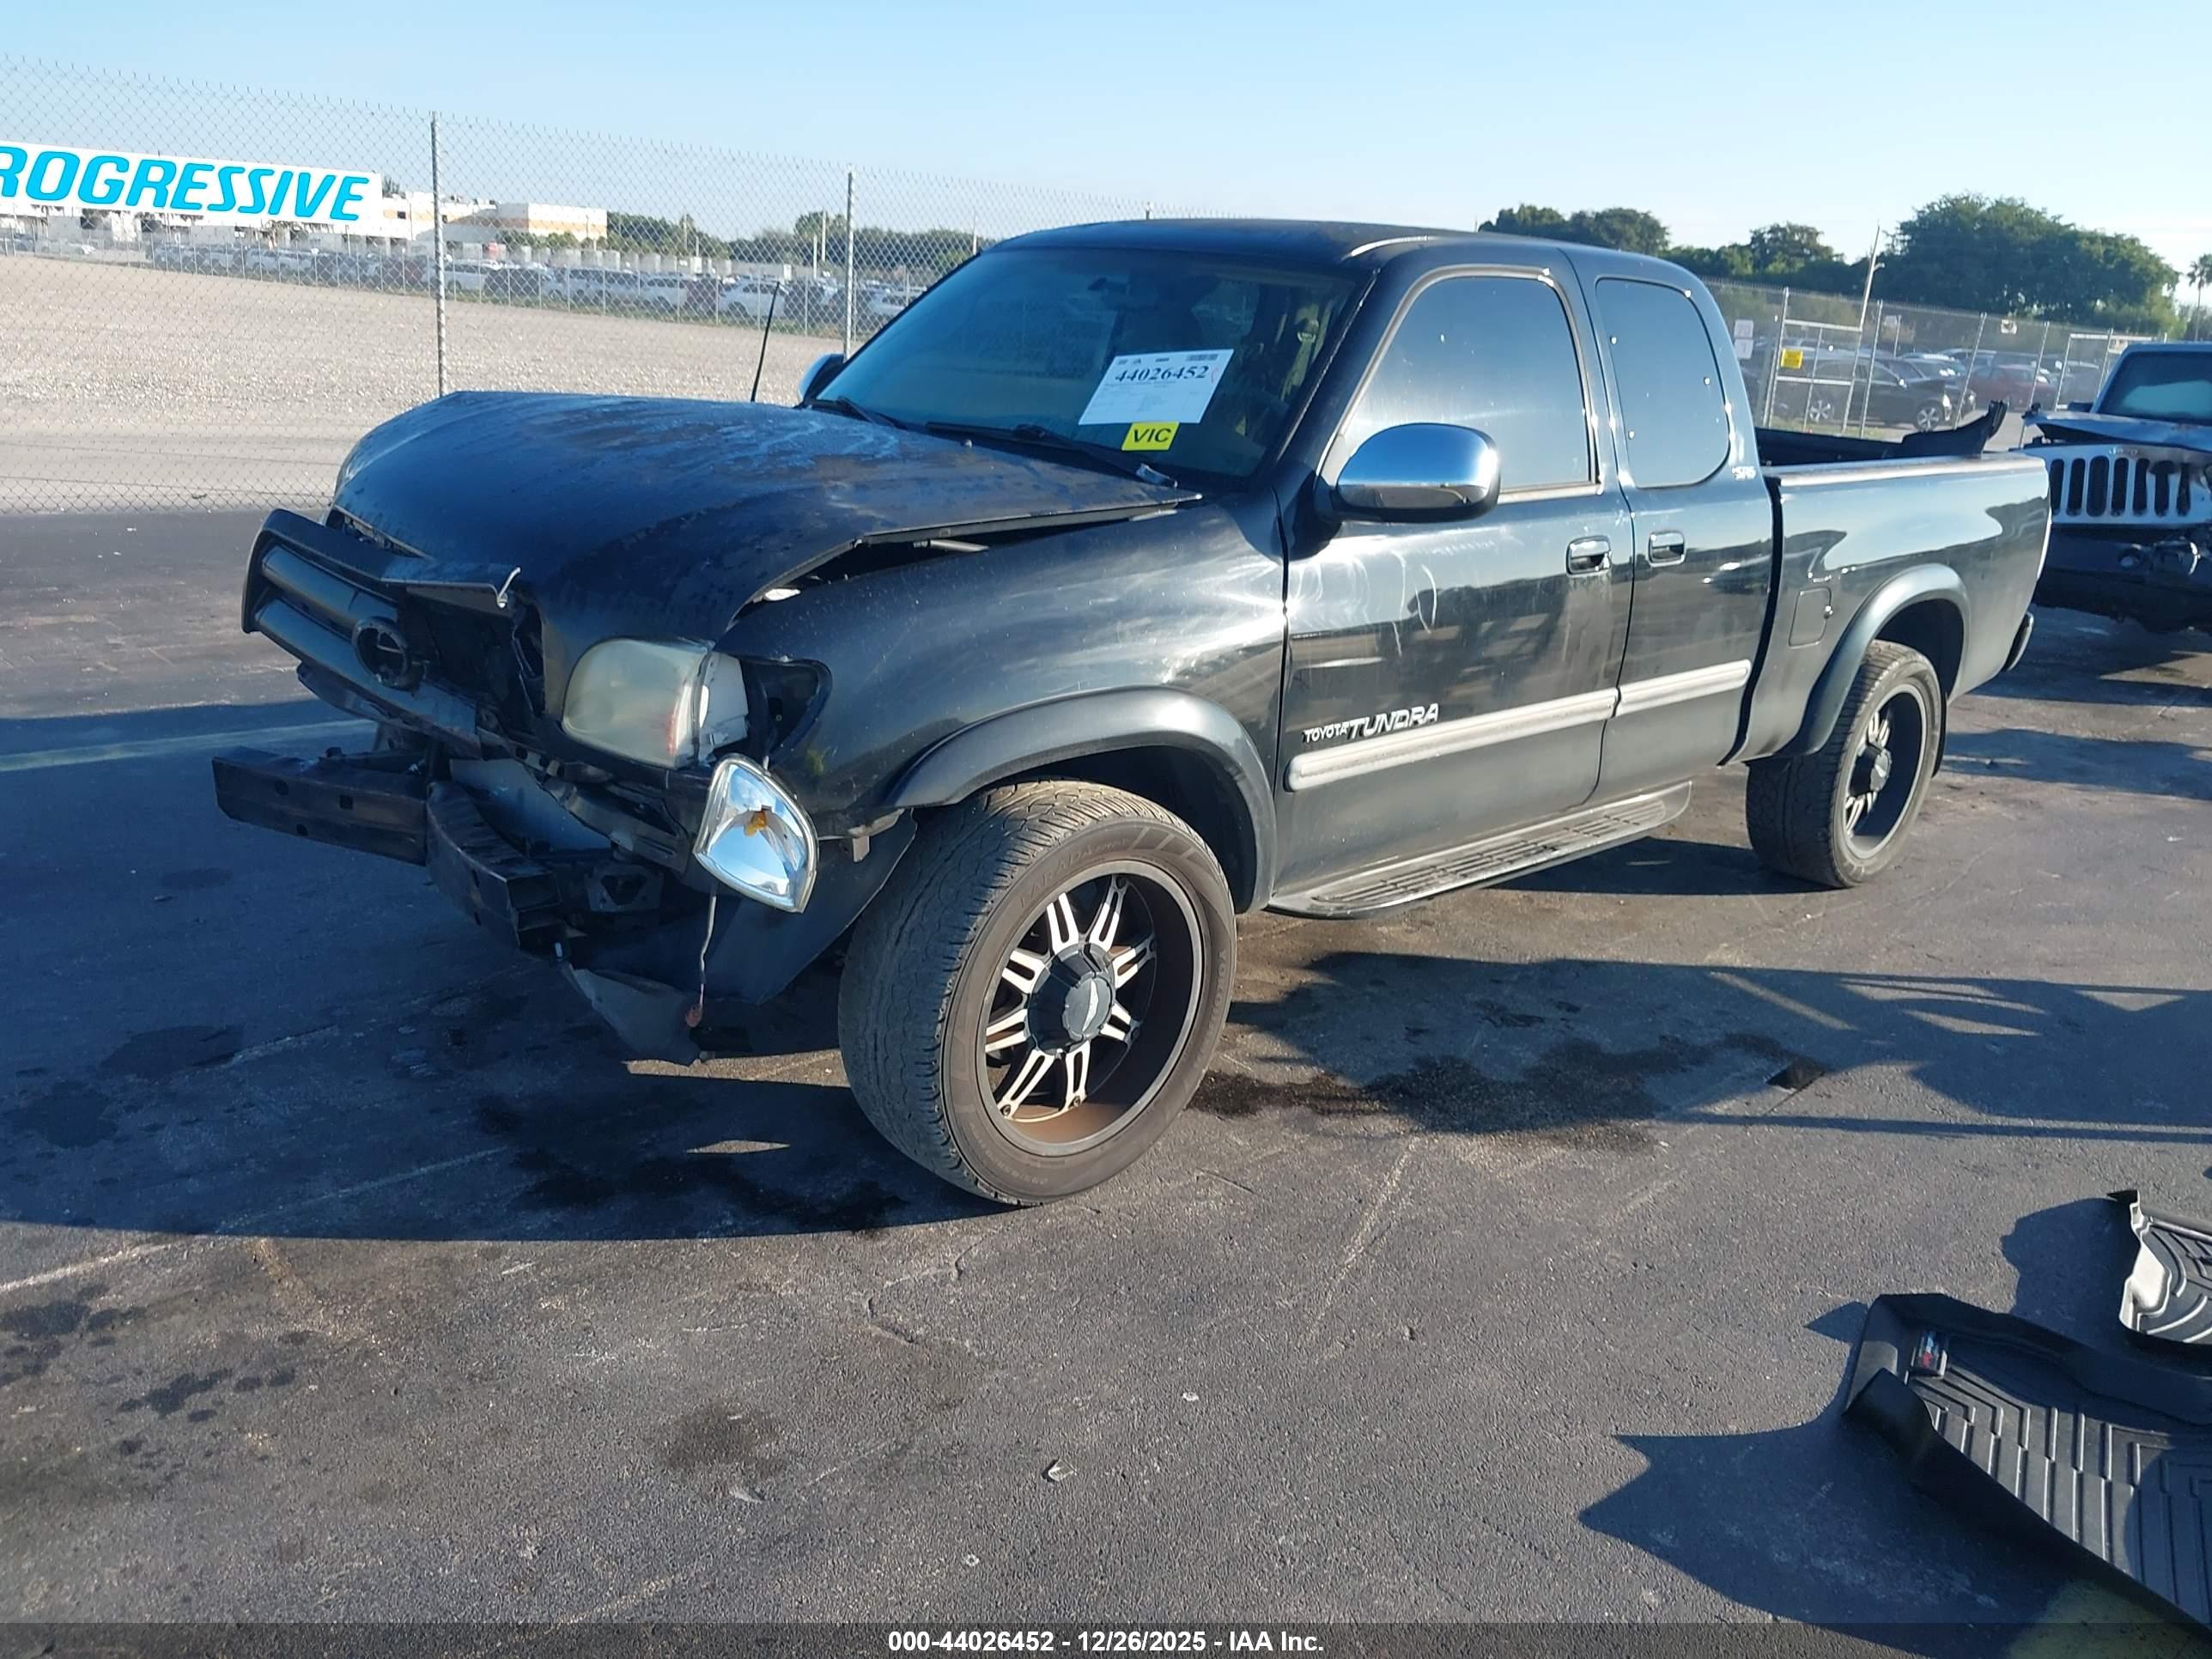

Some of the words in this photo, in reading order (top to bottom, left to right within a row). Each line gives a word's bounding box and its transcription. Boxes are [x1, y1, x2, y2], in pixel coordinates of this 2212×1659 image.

[0, 146, 369, 221] ROGRESSIVE
[1115, 365, 1209, 382] 44026452
[1133, 428, 1172, 444] VIC
[1303, 722, 1349, 743] TOYOTA
[1347, 702, 1439, 739] TUNDRA
